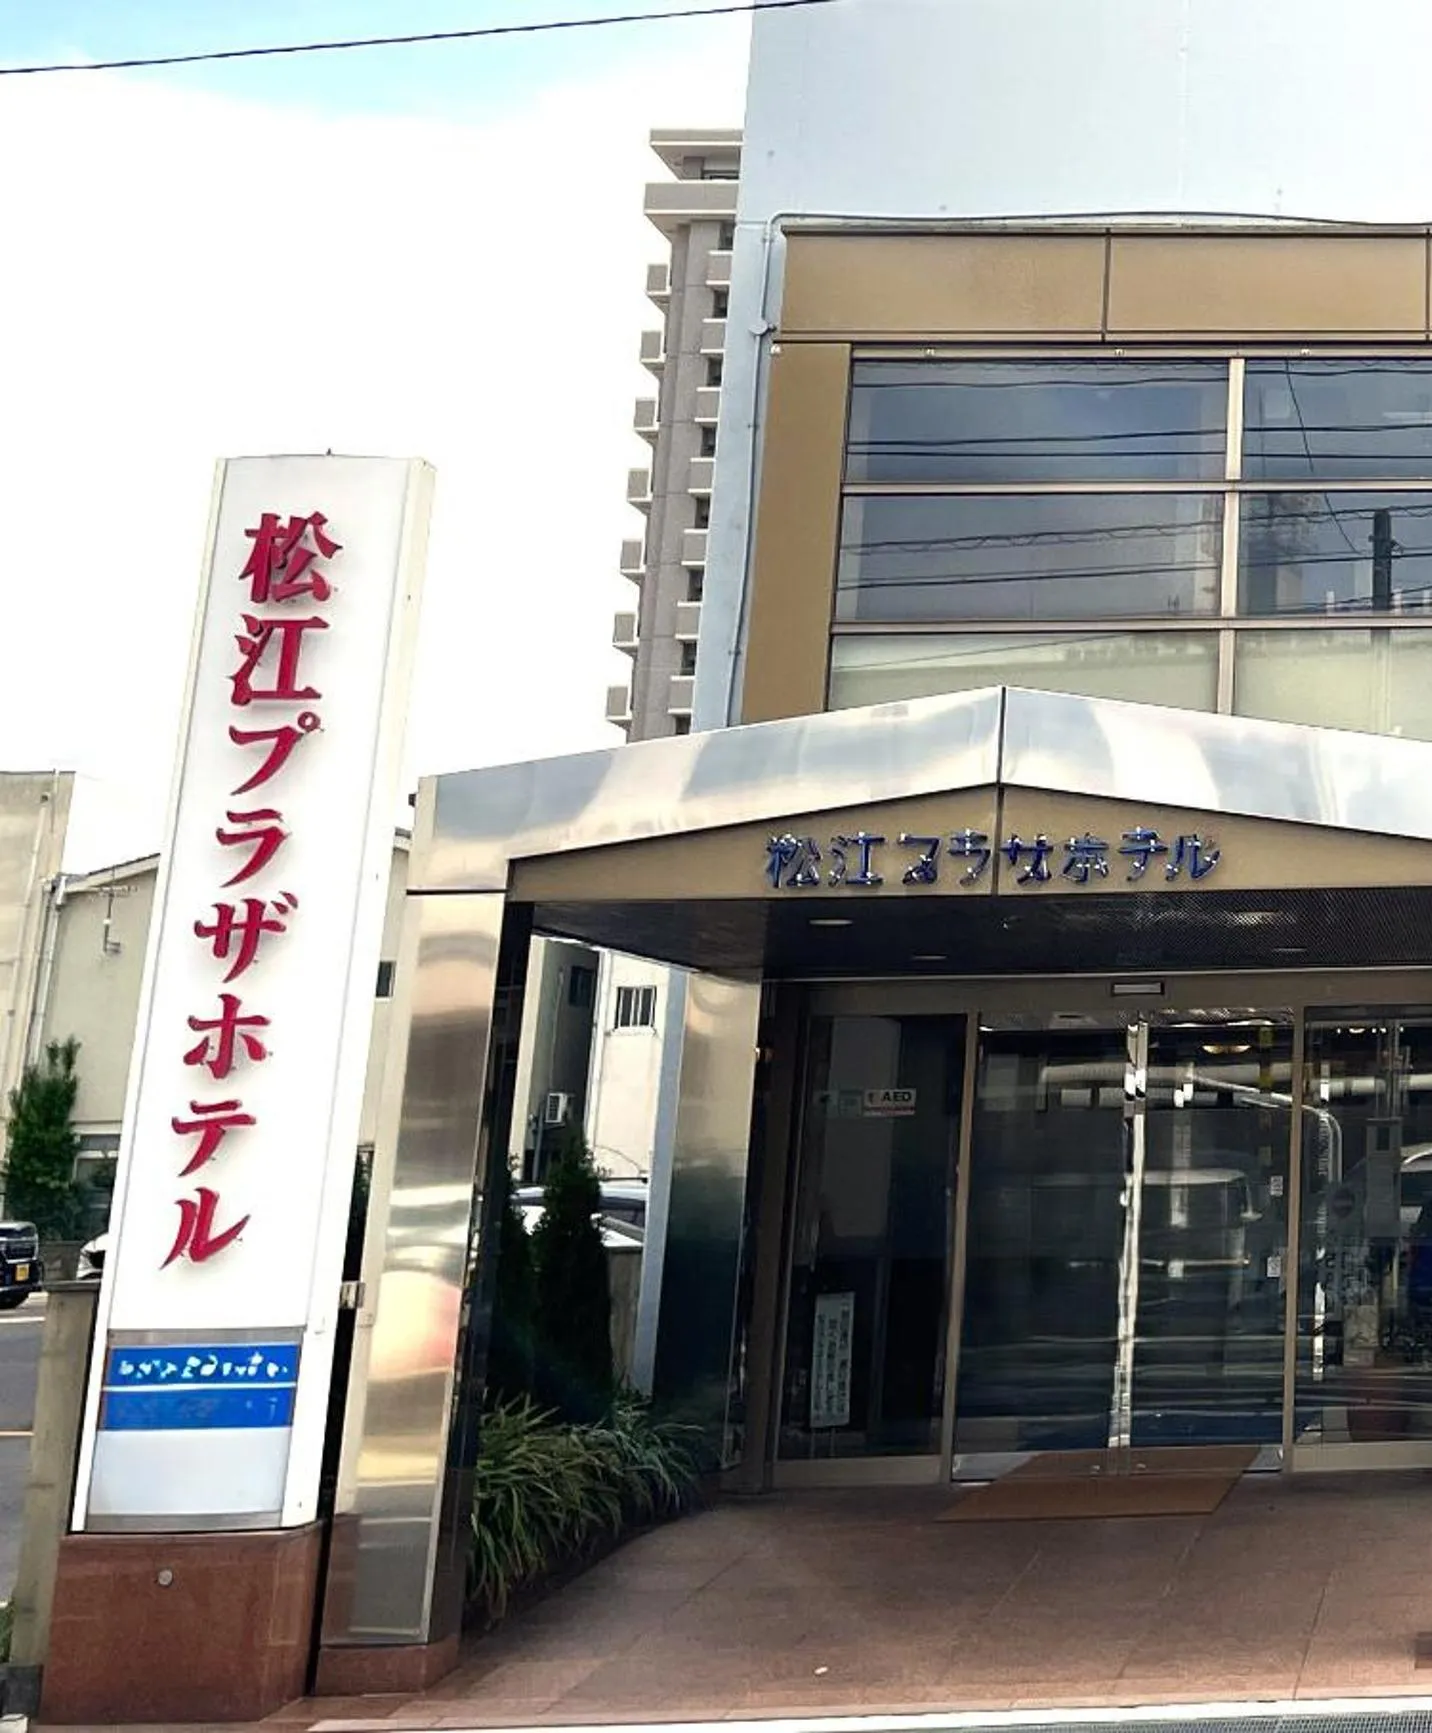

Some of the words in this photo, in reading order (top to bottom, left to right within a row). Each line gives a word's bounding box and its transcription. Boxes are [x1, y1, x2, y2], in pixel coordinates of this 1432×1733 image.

[161, 510, 343, 1270] 松江プラザホテル
[882, 1091, 912, 1102] AED
